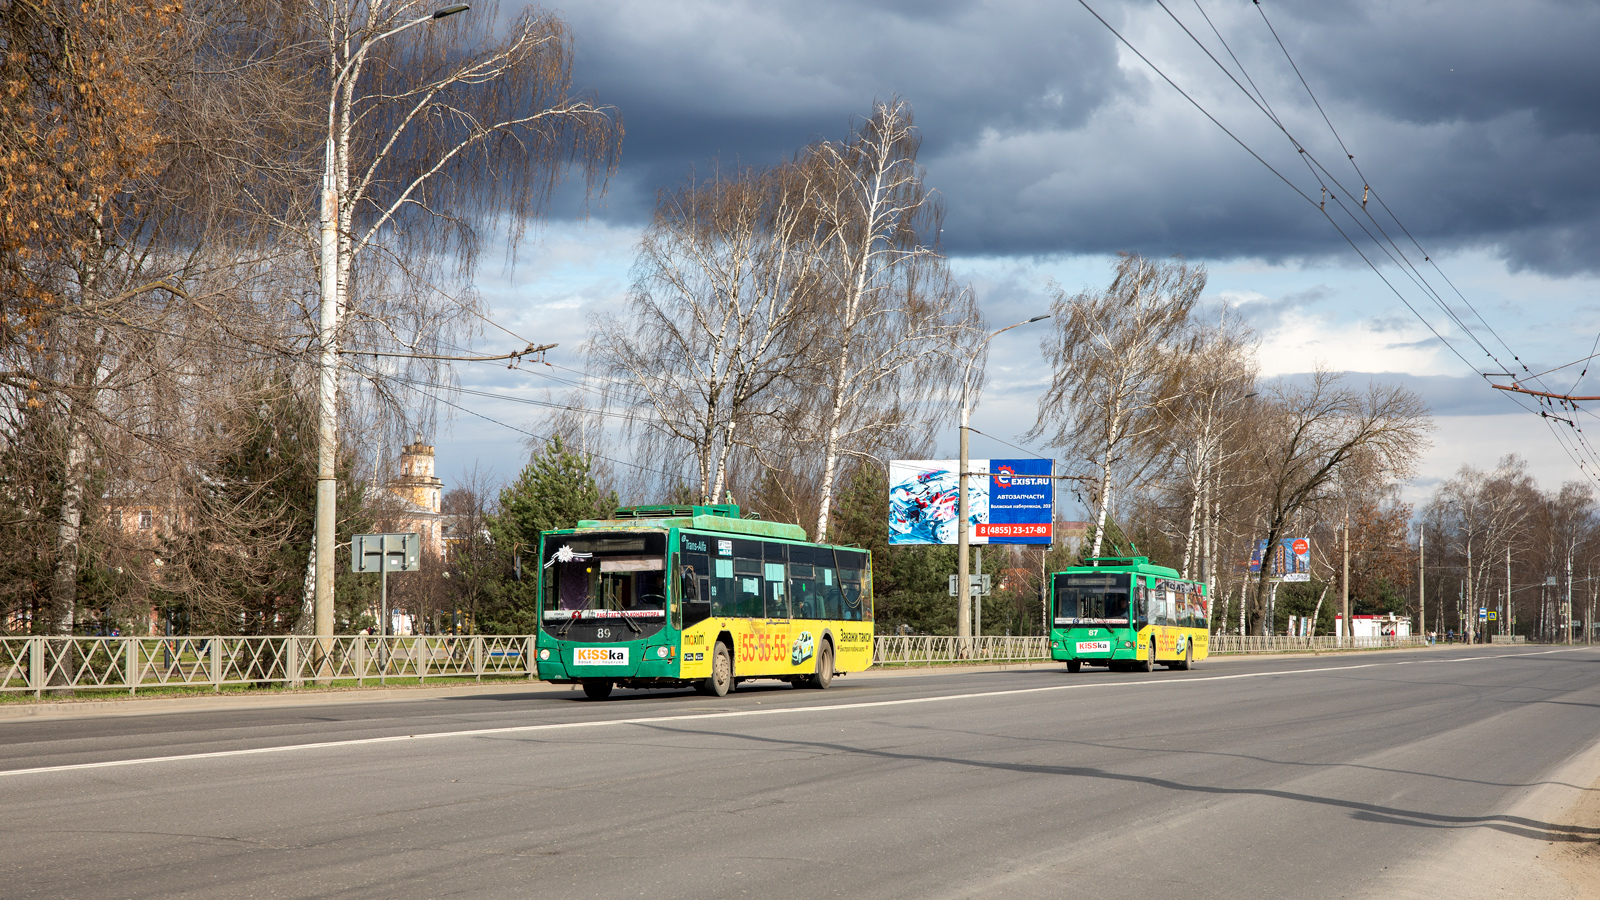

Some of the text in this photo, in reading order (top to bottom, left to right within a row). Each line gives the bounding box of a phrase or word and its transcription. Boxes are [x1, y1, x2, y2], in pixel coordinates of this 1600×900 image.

[980, 525, 1047, 535] 8 (4855) 23-17-80
[597, 628, 611, 639] 89
[683, 631, 705, 646] maxim
[839, 628, 858, 643] Закажи
[1088, 629, 1099, 637] 87
